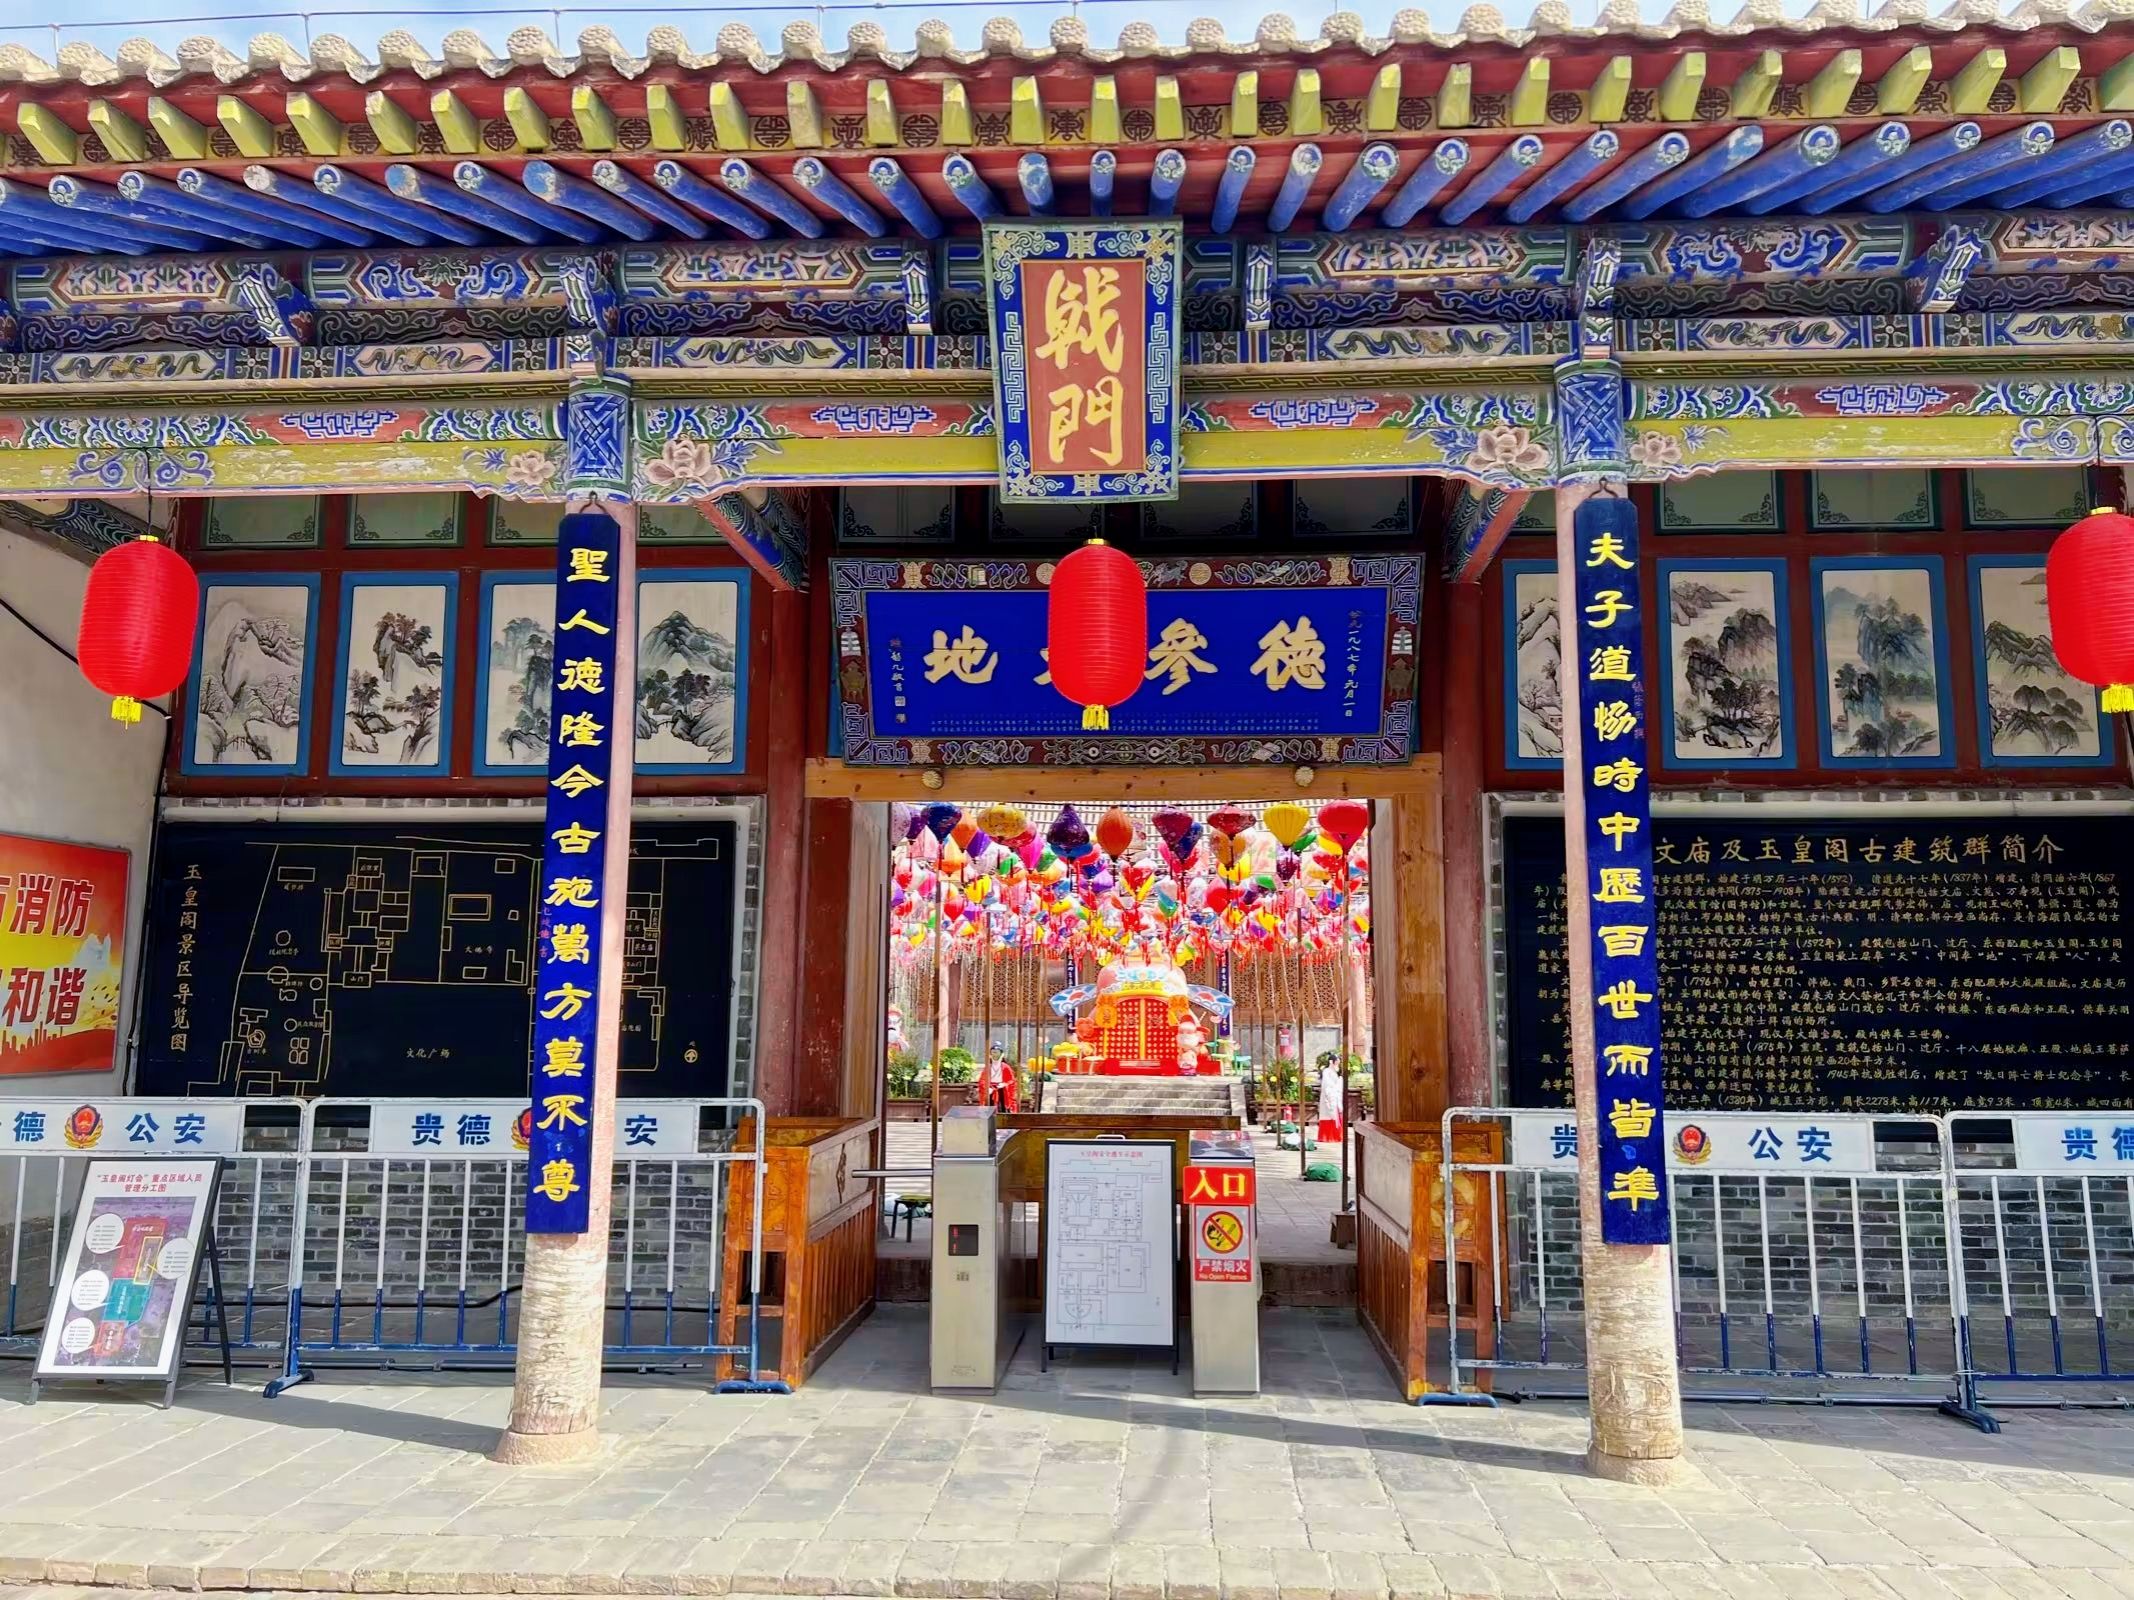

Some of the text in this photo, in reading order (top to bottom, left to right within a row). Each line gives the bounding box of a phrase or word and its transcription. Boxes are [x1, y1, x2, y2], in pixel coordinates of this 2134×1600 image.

[1653, 834, 2065, 864] 文庙及玉皇阁古建筑群简介
[170, 863, 203, 1052] 玉皇阁景区导览图
[0, 966, 87, 1028] 和谐
[124, 1112, 206, 1144] 公安
[411, 1113, 492, 1146] 贵德
[1747, 1126, 1833, 1162] 公安
[1188, 1169, 1246, 1200] 入口
[1198, 1260, 1248, 1273] 严禁烟火
